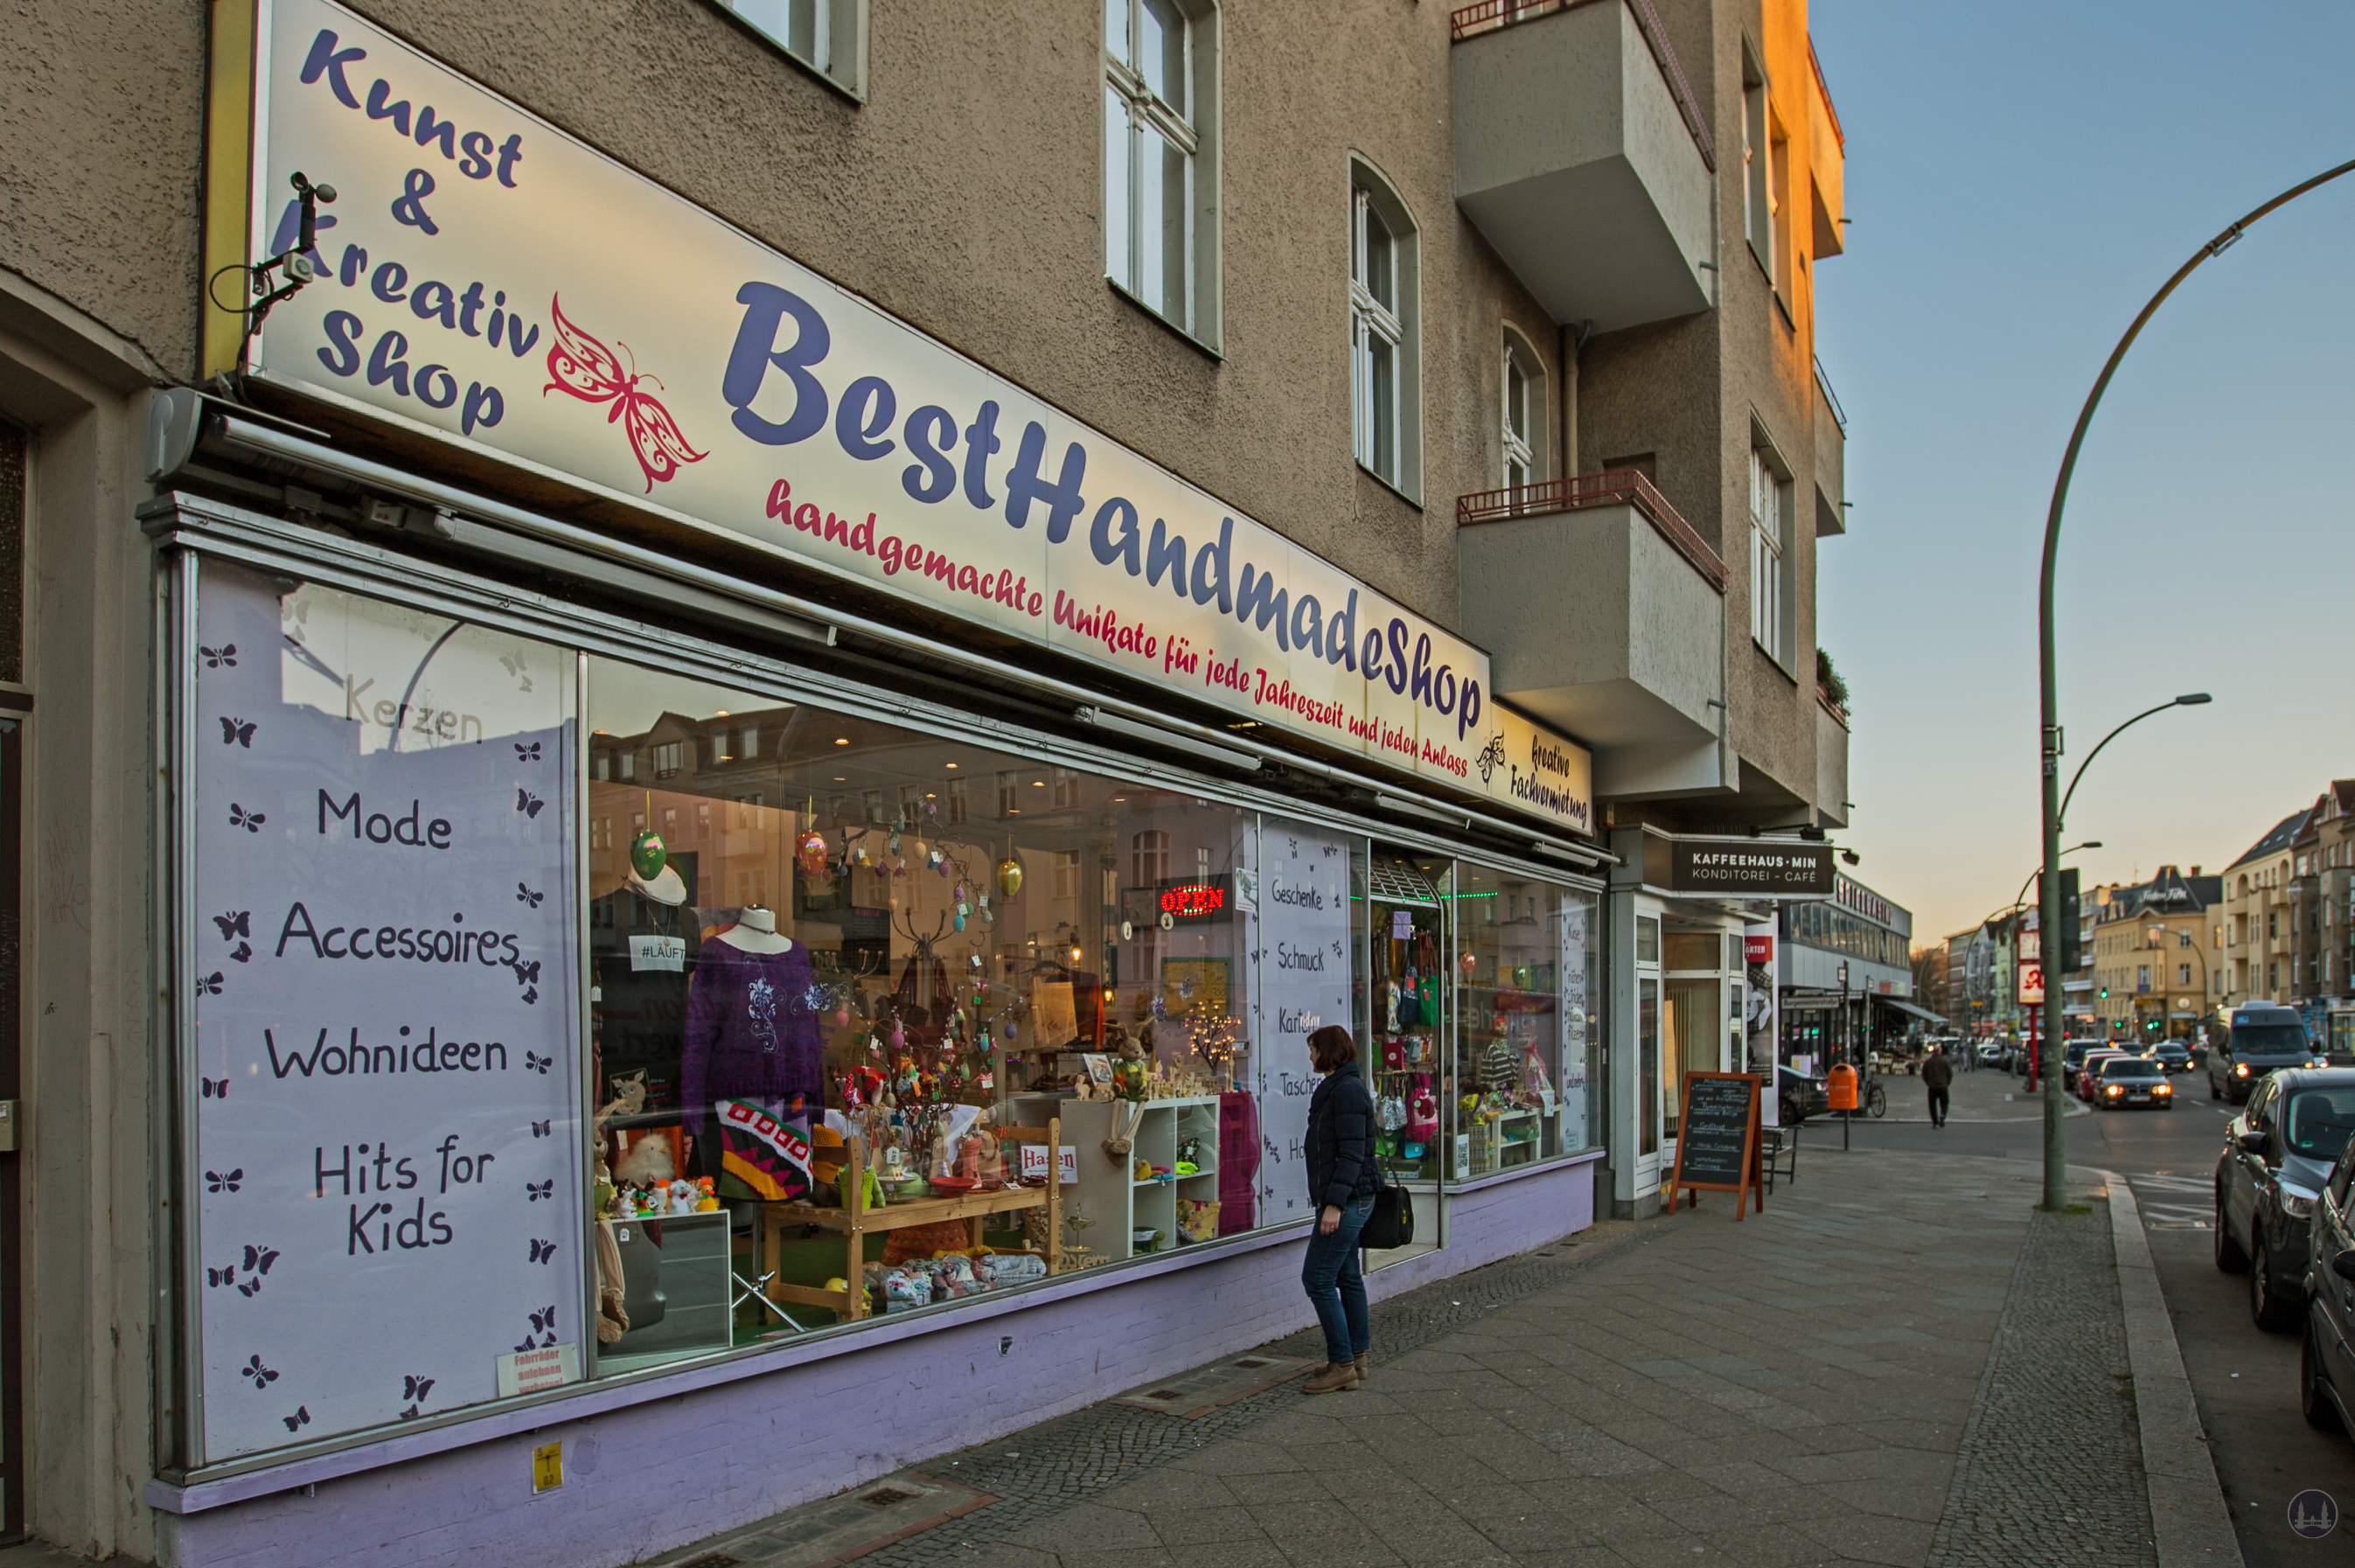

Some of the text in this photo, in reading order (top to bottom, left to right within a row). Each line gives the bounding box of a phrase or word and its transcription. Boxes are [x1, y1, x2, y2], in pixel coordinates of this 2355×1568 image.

[300, 29, 523, 188] Kunst
[391, 168, 439, 235] &
[270, 199, 539, 358] Kreativ
[317, 310, 505, 436] Shop
[722, 281, 1481, 742] BestHandmadeShop
[765, 478, 1468, 778] handgemachte Unikate für jede Jahreszeit und jeden Anlass
[345, 673, 483, 744] Kerzen
[318, 789, 452, 849] Mode
[1510, 763, 1587, 829] Fachvermietung
[1160, 889, 1224, 911] OPEN
[1272, 879, 1324, 911] Geschenke
[1693, 868, 1770, 881] KONDITOREI
[1785, 870, 1816, 882] CAFÉ
[275, 902, 520, 966] Accessoires
[642, 944, 686, 960] #LÄUFT
[1278, 942, 1325, 972] Schmuck
[264, 1026, 508, 1078] Wohnideen
[316, 1135, 496, 1198] Hits for
[348, 1197, 453, 1255] Kids
[514, 1349, 560, 1366] Fahrräder
[518, 1364, 561, 1381] anlehnen
